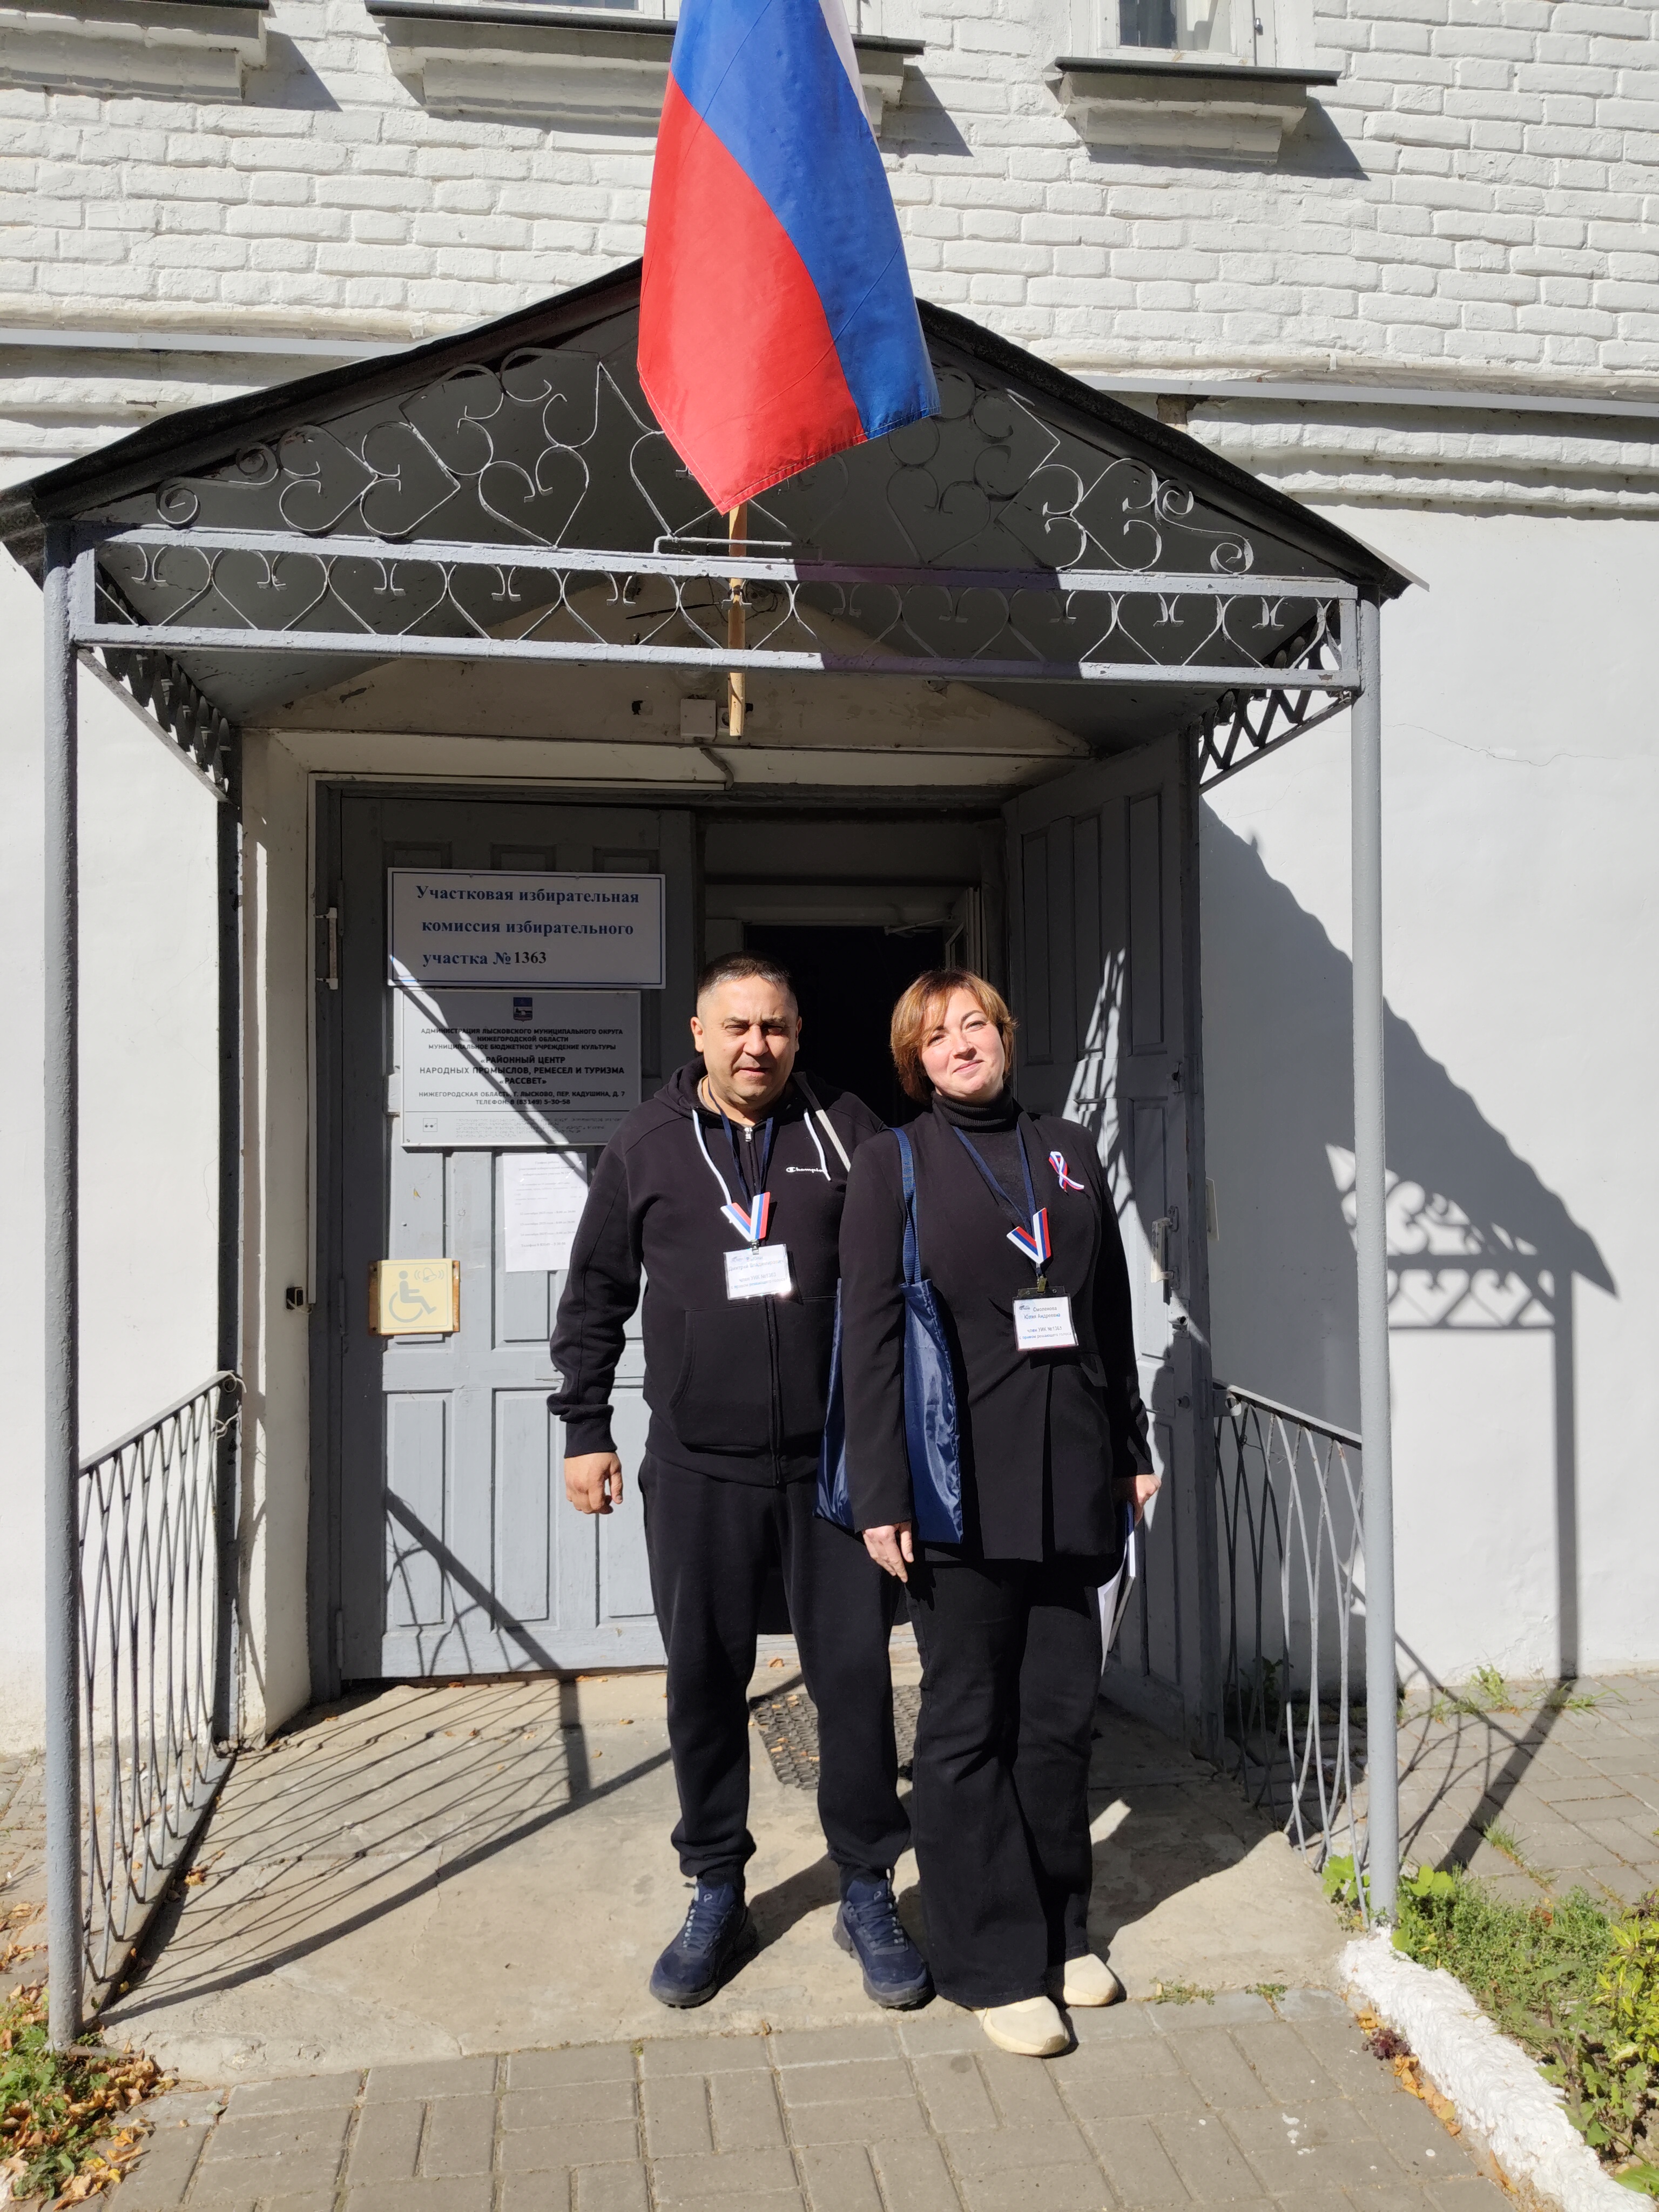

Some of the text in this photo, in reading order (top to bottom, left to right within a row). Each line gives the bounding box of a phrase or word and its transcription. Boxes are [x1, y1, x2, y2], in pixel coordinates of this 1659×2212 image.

[415, 885, 639, 905] Участковая избирательная
[421, 921, 633, 937] комиссия избирательного
[422, 952, 488, 968] участка
[480, 1055, 566, 1064] «РАЙОННЫЙ ЦЕНТР
[473, 1067, 532, 1075] ПРОМЫСЛОВ,
